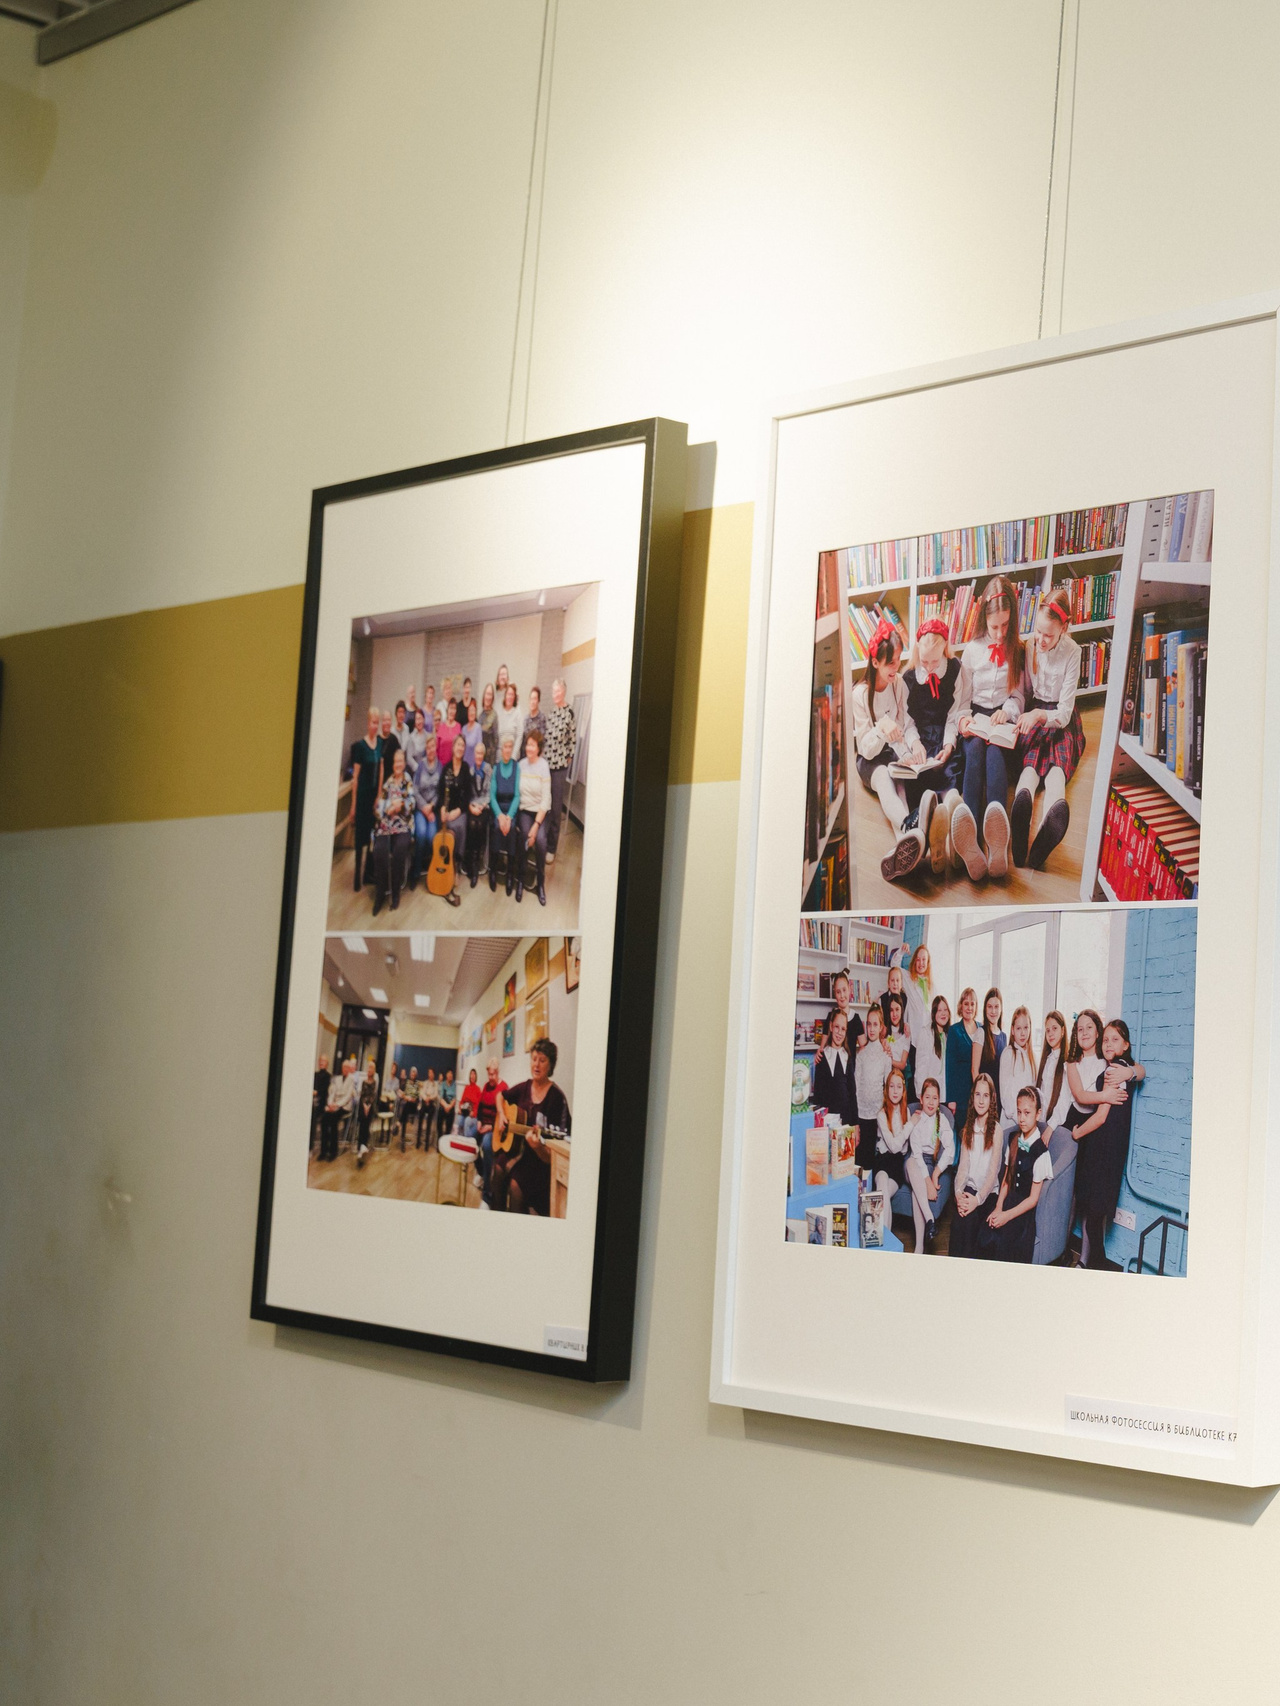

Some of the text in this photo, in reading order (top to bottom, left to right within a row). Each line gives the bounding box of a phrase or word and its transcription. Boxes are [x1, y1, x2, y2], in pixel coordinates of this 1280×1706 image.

[1070, 1410, 1109, 1425] ШКОЛЬНАЯ
[1111, 1415, 1164, 1432] ФОТОСЕССИЯ
[1166, 1424, 1171, 1433] В
[1174, 1424, 1225, 1441] БИБЛИОТЕКЕ
